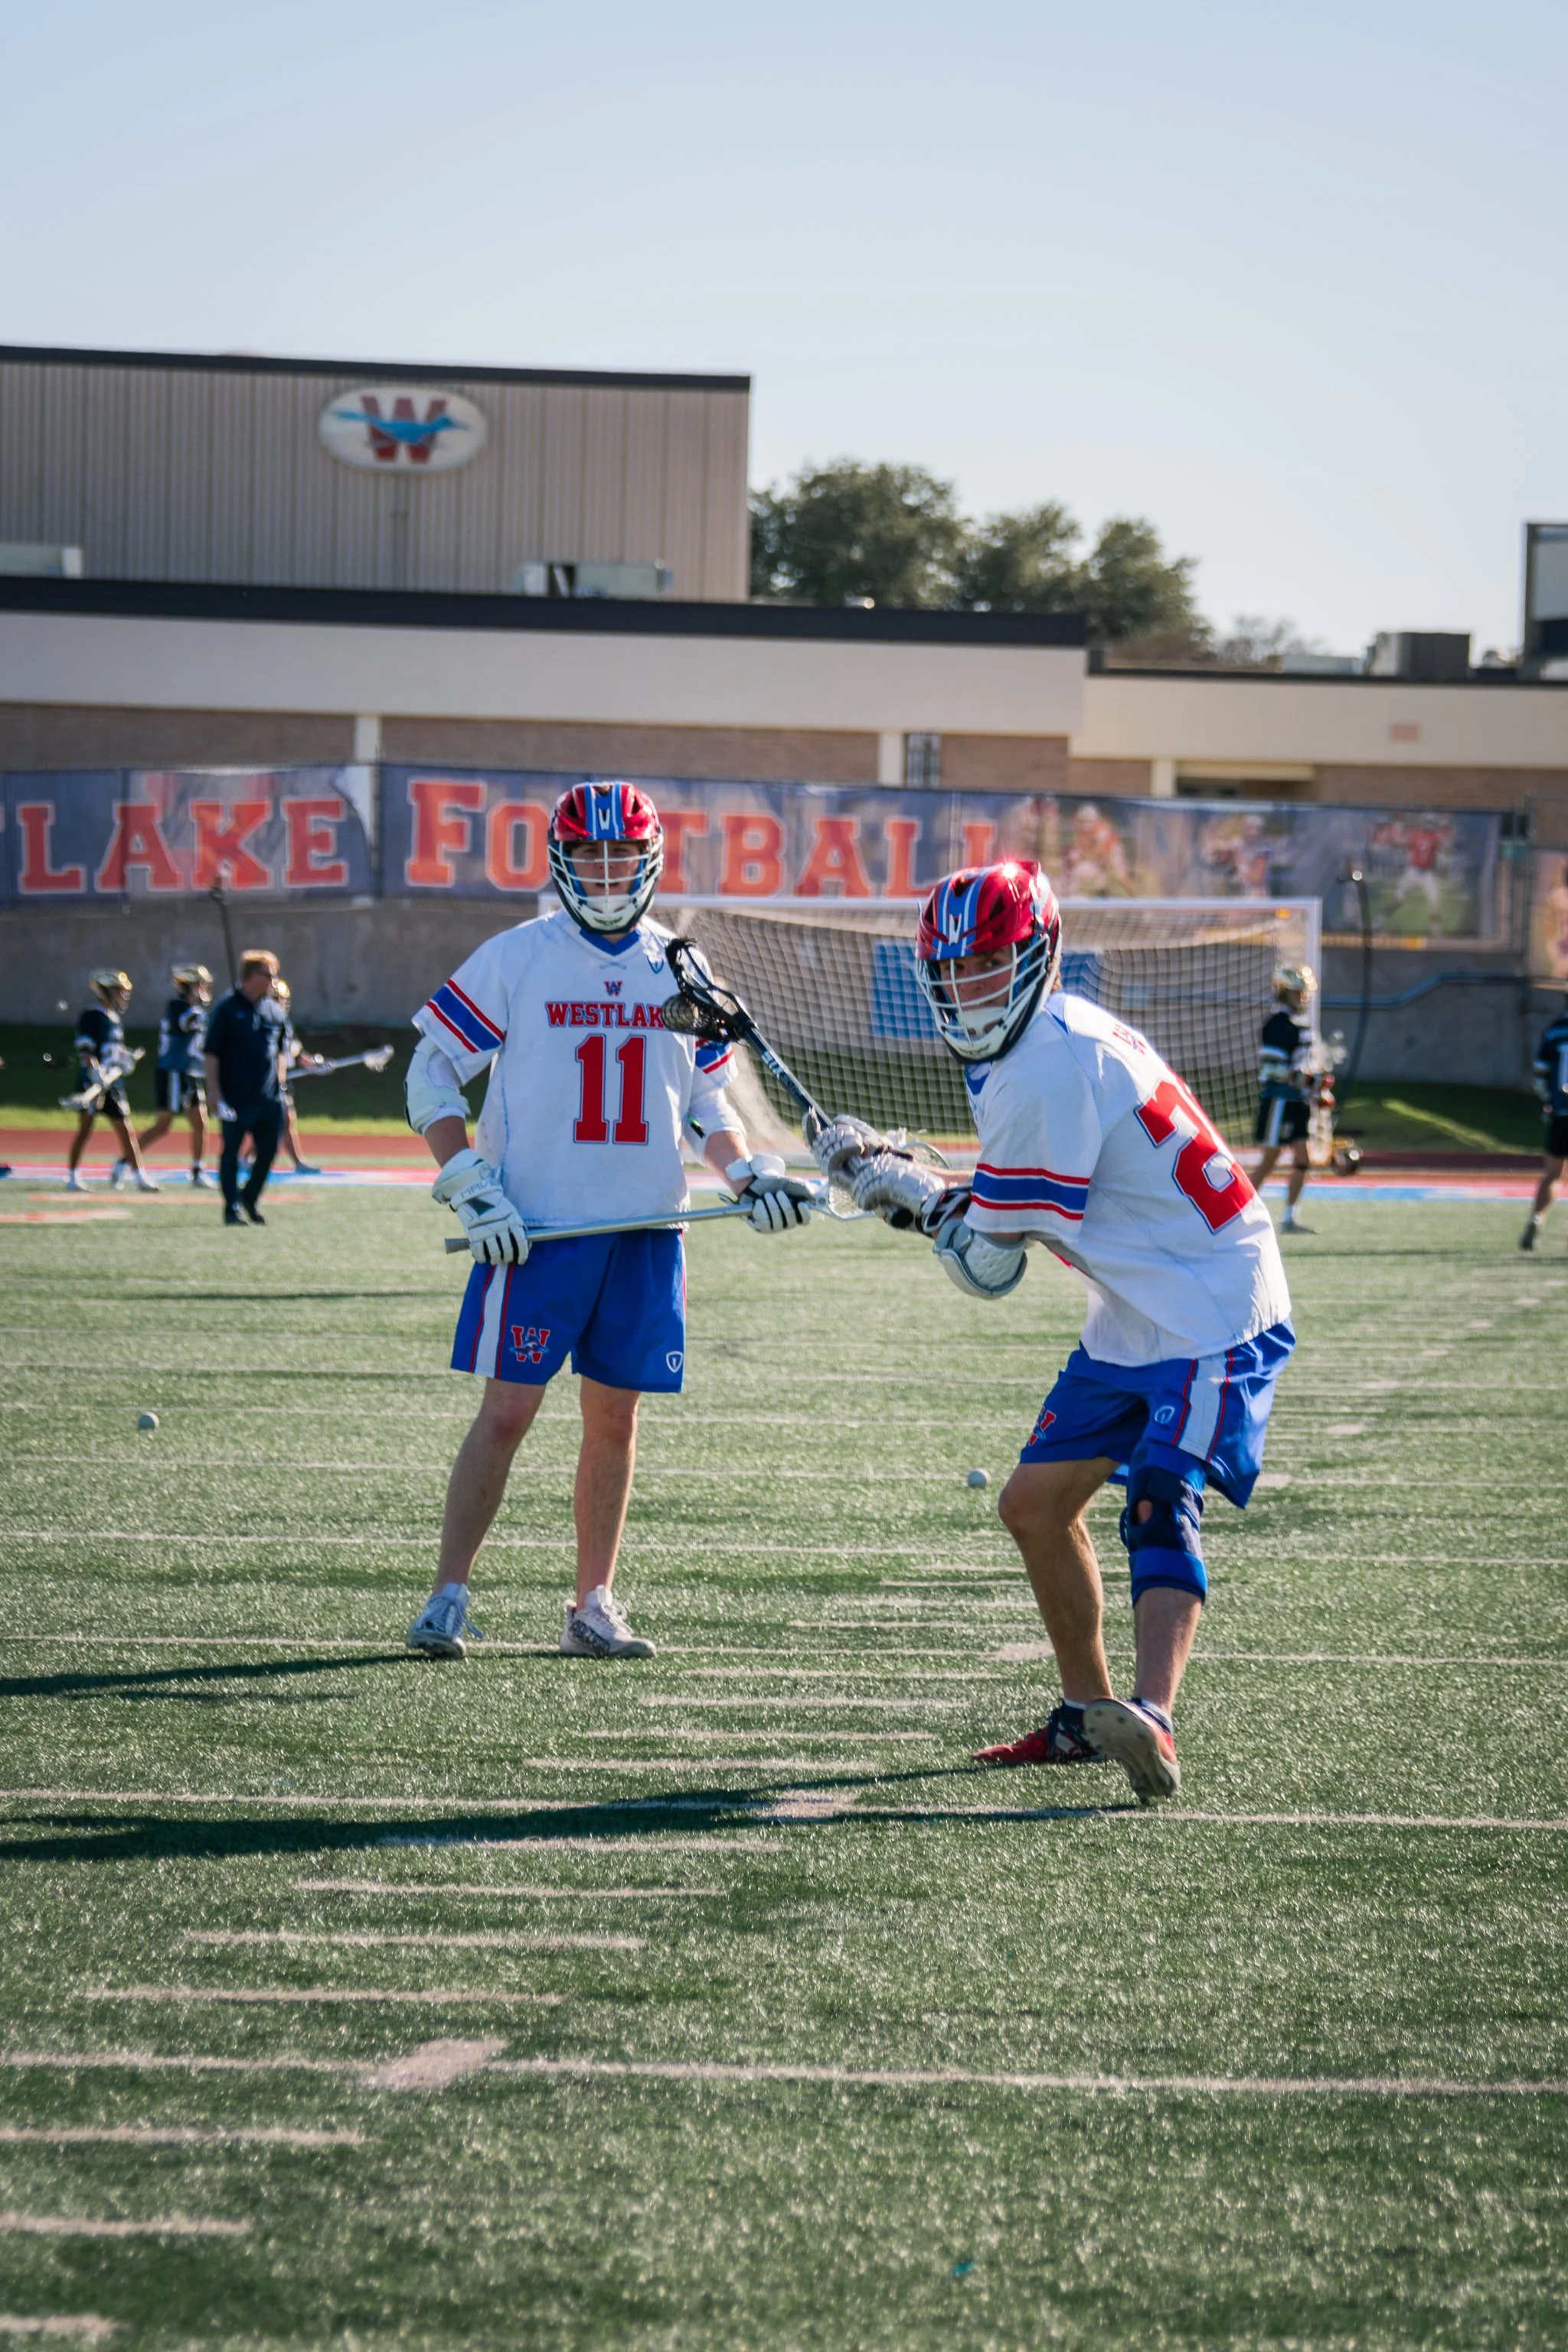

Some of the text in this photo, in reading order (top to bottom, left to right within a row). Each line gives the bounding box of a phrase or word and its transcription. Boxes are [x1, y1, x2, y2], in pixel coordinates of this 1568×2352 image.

[0, 779, 996, 899] LAKE FOTBAL
[545, 1001, 665, 1028] WESTLAK
[573, 1033, 649, 1146] 11
[1133, 1064, 1257, 1236] 2
